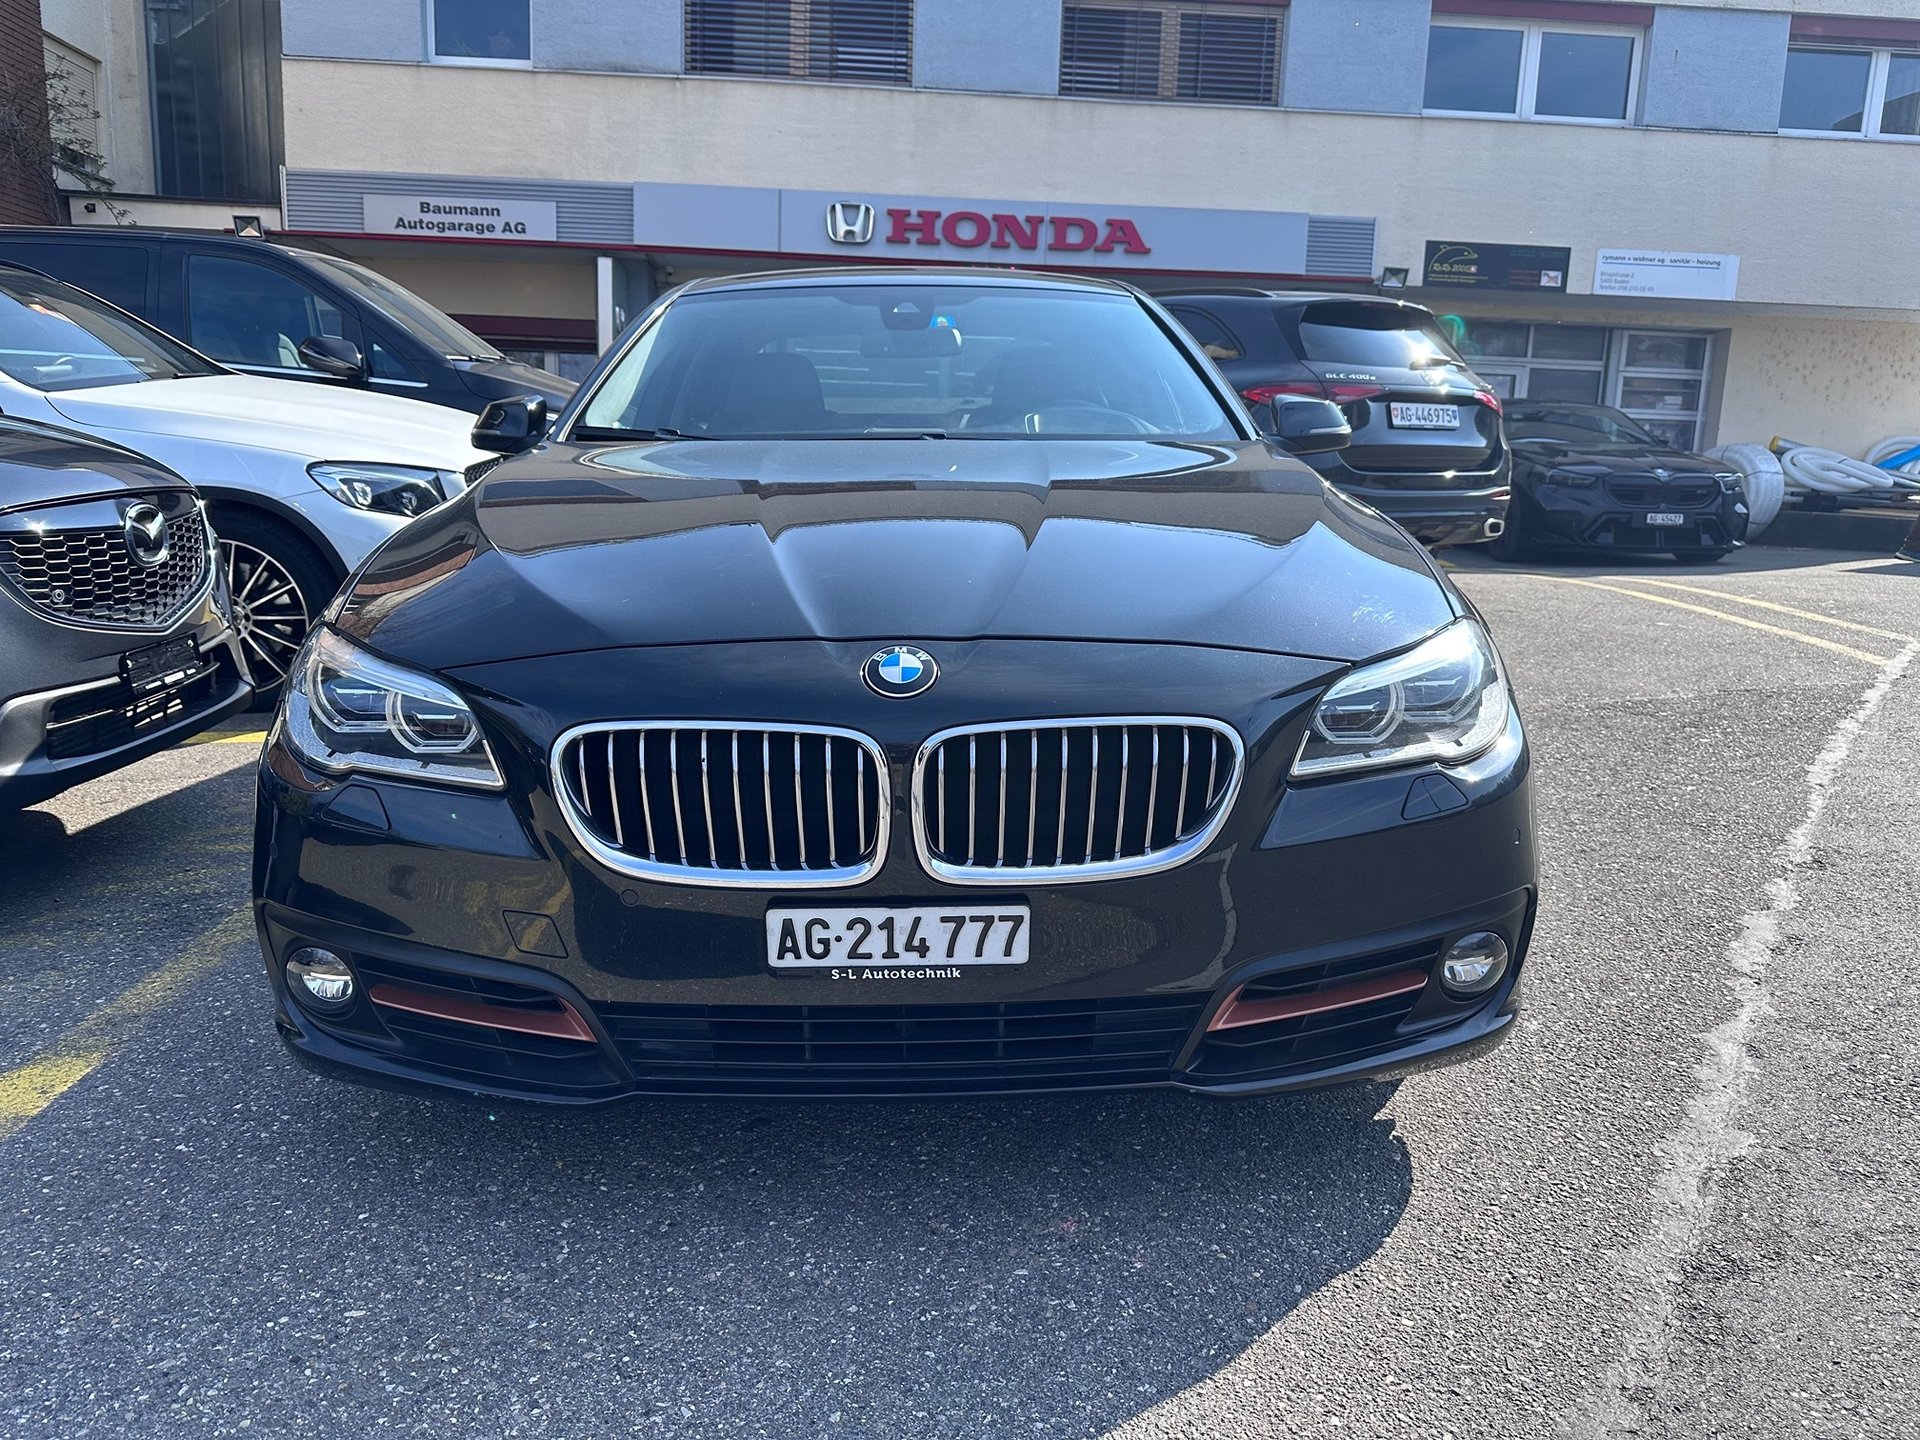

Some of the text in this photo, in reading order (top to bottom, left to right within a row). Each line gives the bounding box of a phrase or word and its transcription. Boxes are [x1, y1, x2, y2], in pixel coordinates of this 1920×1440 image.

[419, 201, 501, 217] Baumann
[395, 216, 527, 235] Autogarage AG
[886, 207, 1153, 254] HONDA
[1602, 254, 1626, 263] rymann
[1633, 255, 1656, 263] widmer
[1696, 259, 1721, 267] heizung
[872, 646, 930, 662] BMW
[831, 968, 961, 980] S-L Autotechnik
